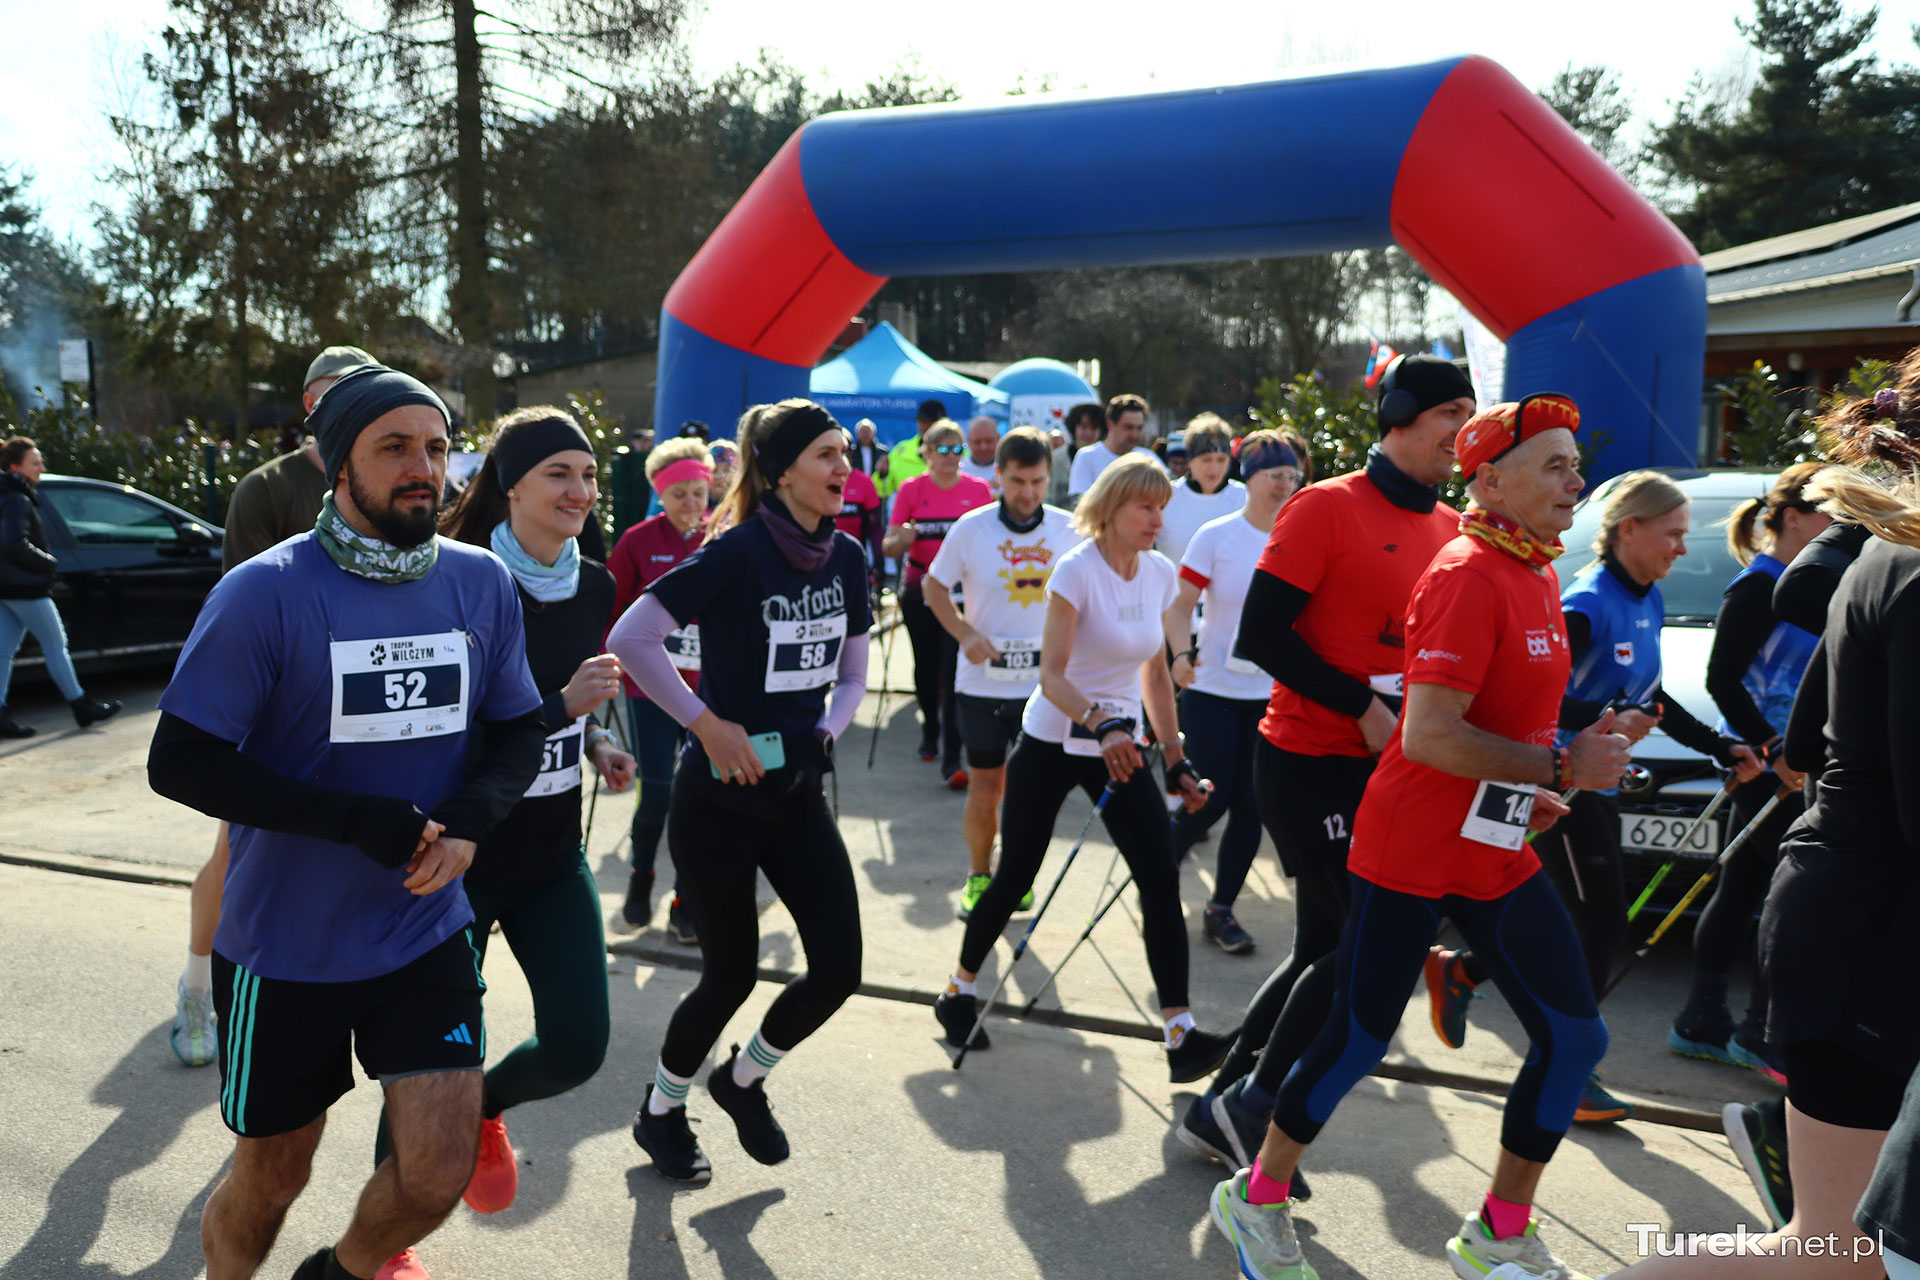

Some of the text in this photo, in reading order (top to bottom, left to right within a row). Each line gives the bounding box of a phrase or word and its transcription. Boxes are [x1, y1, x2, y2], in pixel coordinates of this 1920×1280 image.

[1118, 604, 1145, 622] NIKE
[391, 641, 414, 649] TROPEM
[391, 647, 435, 661] WILCZYM
[800, 642, 826, 669] 58
[1004, 652, 1033, 668] 103
[384, 670, 428, 710] 52
[1323, 813, 1347, 840] 12
